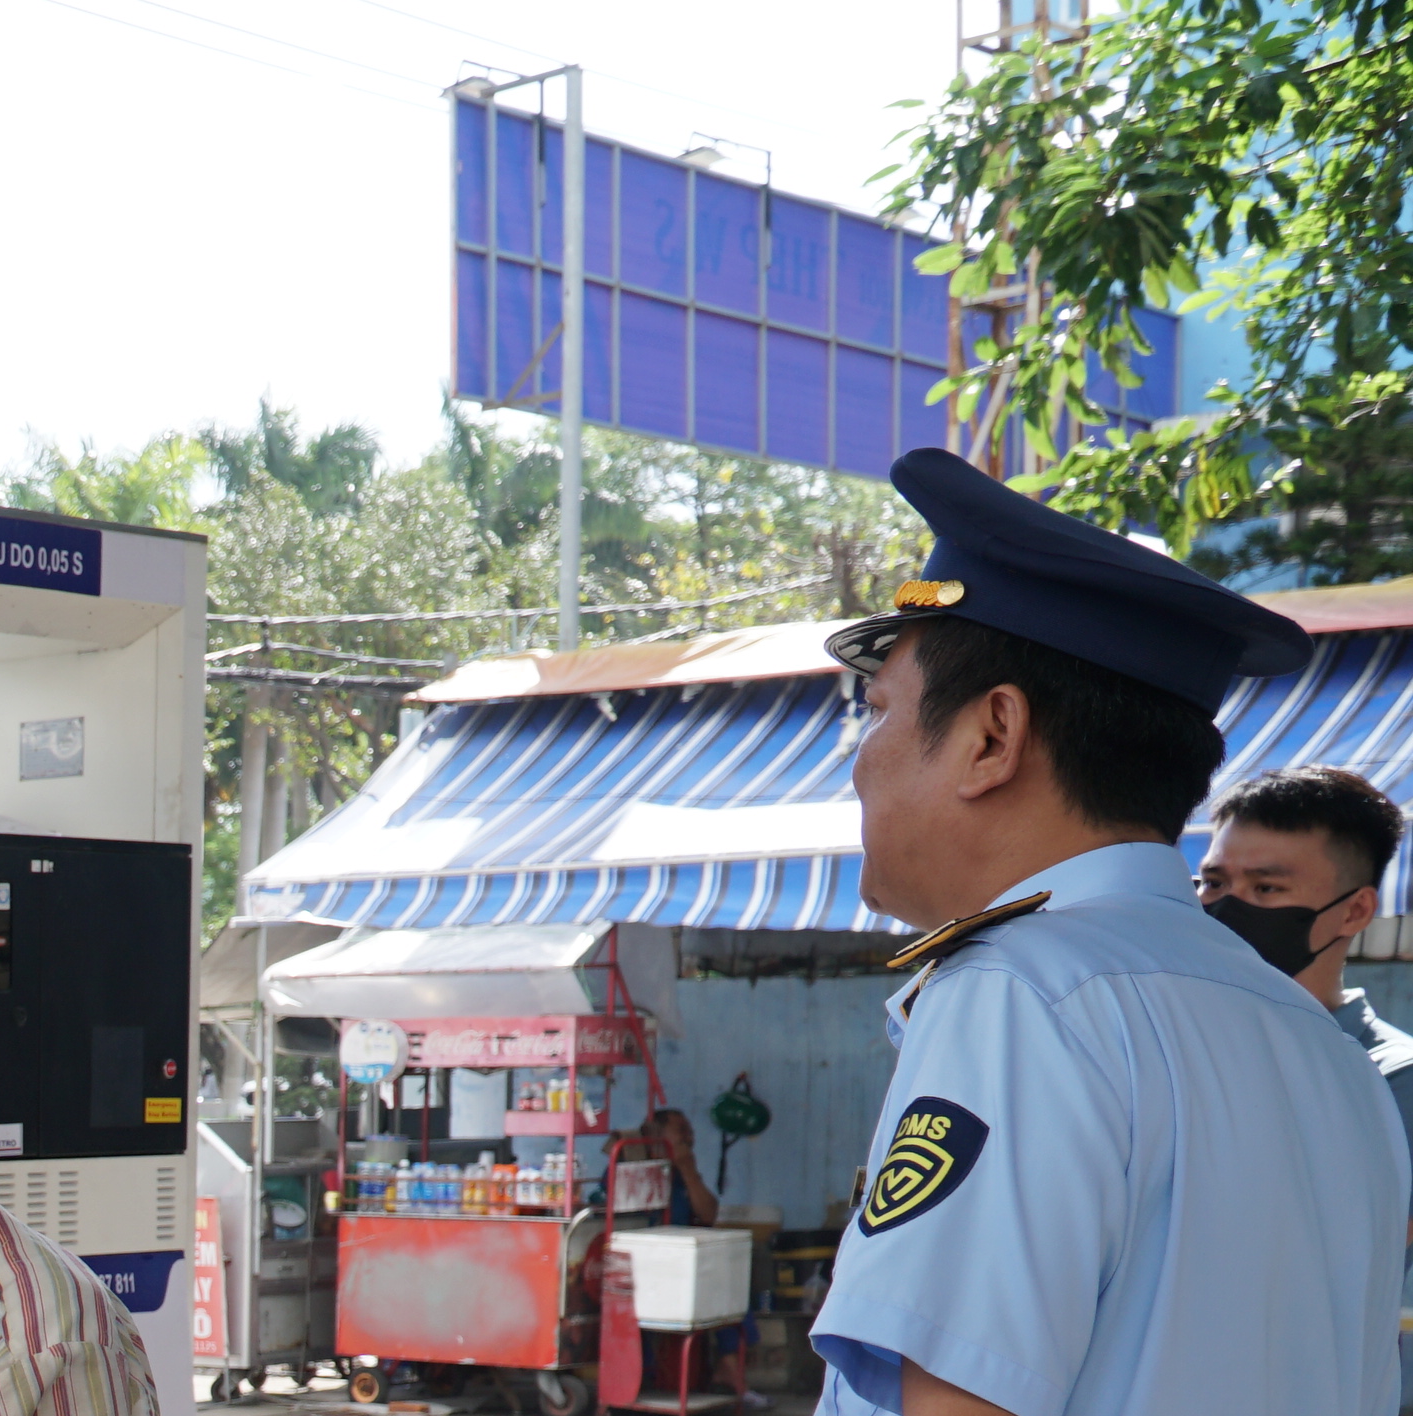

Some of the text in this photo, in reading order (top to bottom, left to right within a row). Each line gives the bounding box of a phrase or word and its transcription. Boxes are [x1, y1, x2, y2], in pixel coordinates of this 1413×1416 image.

[10, 543, 35, 569] DO
[37, 546, 69, 576] 0,05
[72, 551, 84, 576] S
[115, 1272, 135, 1294] 811
